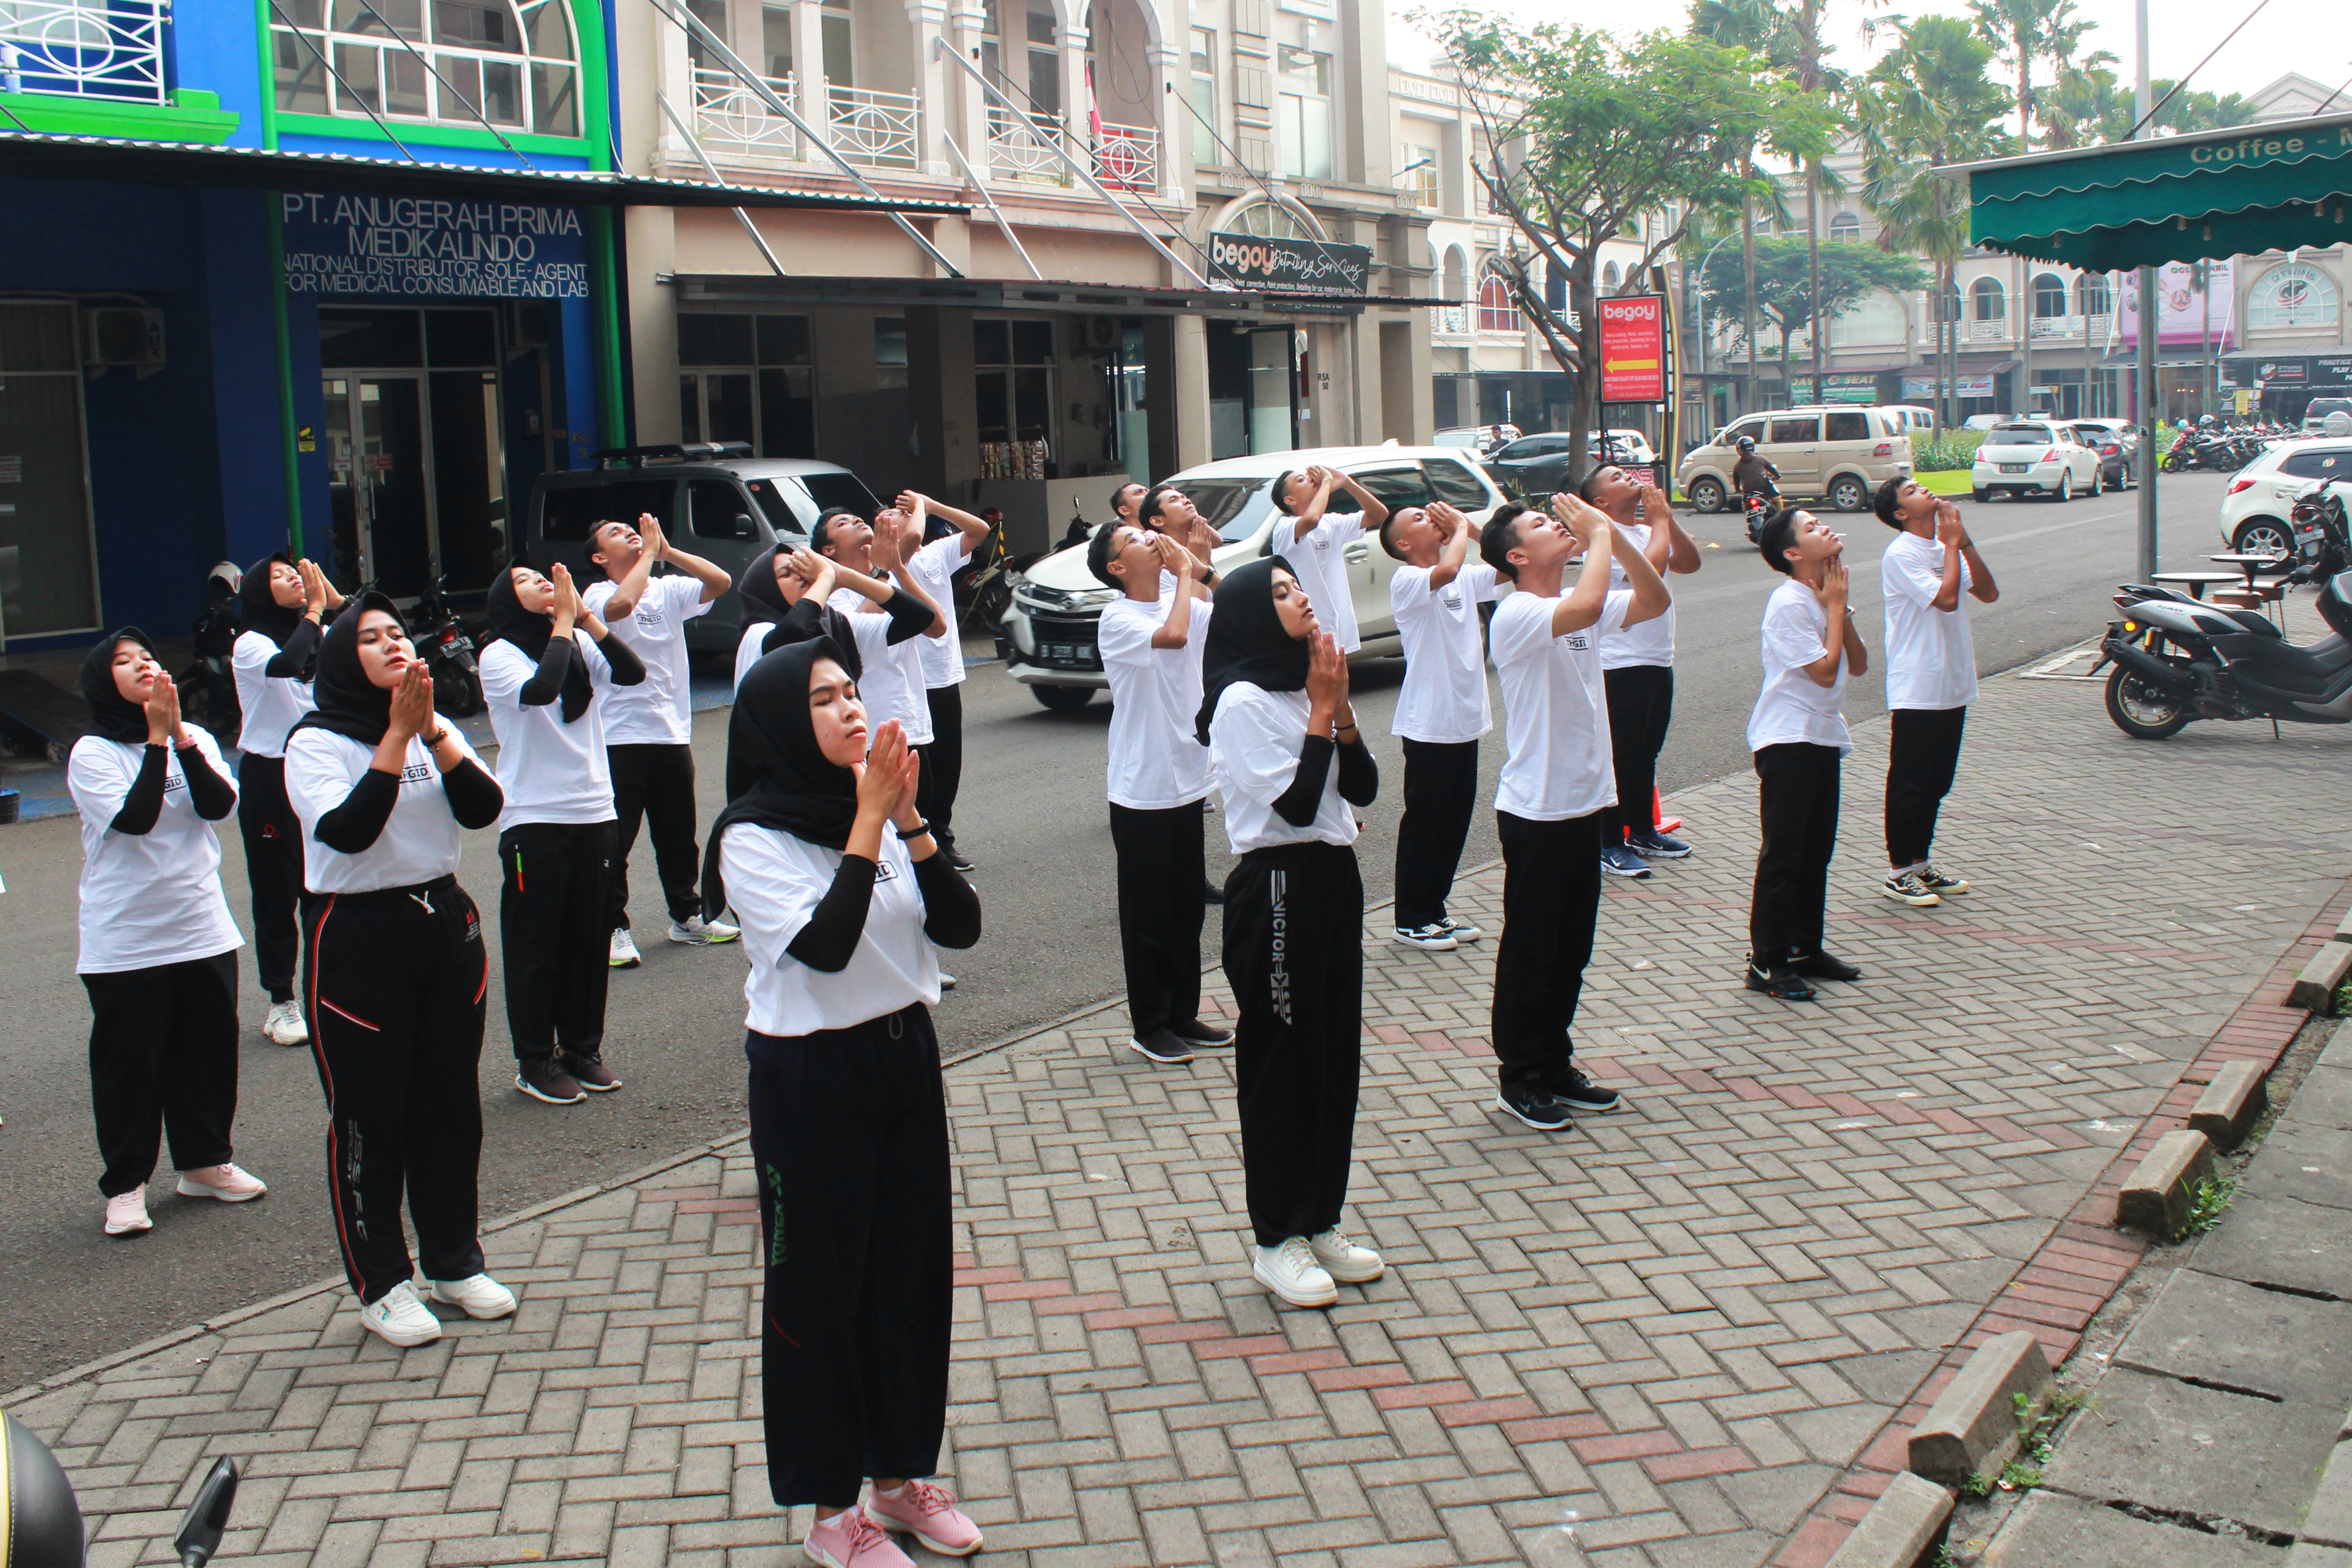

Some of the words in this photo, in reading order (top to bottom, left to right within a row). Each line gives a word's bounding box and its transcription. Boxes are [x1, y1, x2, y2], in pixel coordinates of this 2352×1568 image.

[2191, 138, 2304, 163] Coffee
[283, 193, 329, 224] PT.
[333, 195, 493, 232] ANUGERAH
[501, 204, 582, 236] PRIMA
[349, 226, 535, 262] MEDIKALINDO
[1212, 235, 1275, 276] begoy
[1273, 248, 1314, 279] Detailing
[284, 254, 365, 275] NATIONAL
[366, 256, 483, 281] DISTRIBUTOR,
[534, 264, 588, 281] AGENT
[321, 274, 400, 293] MEDICAL
[403, 276, 518, 296] CONSUMABLE
[521, 279, 555, 297] AND
[558, 280, 589, 297] LAB
[1604, 305, 1655, 321] begoy
[148, 323, 160, 358] AUX
[1844, 375, 1877, 384] SEAT
[1272, 900, 1287, 963] VICTOR
[771, 1200, 787, 1267] YONEX
